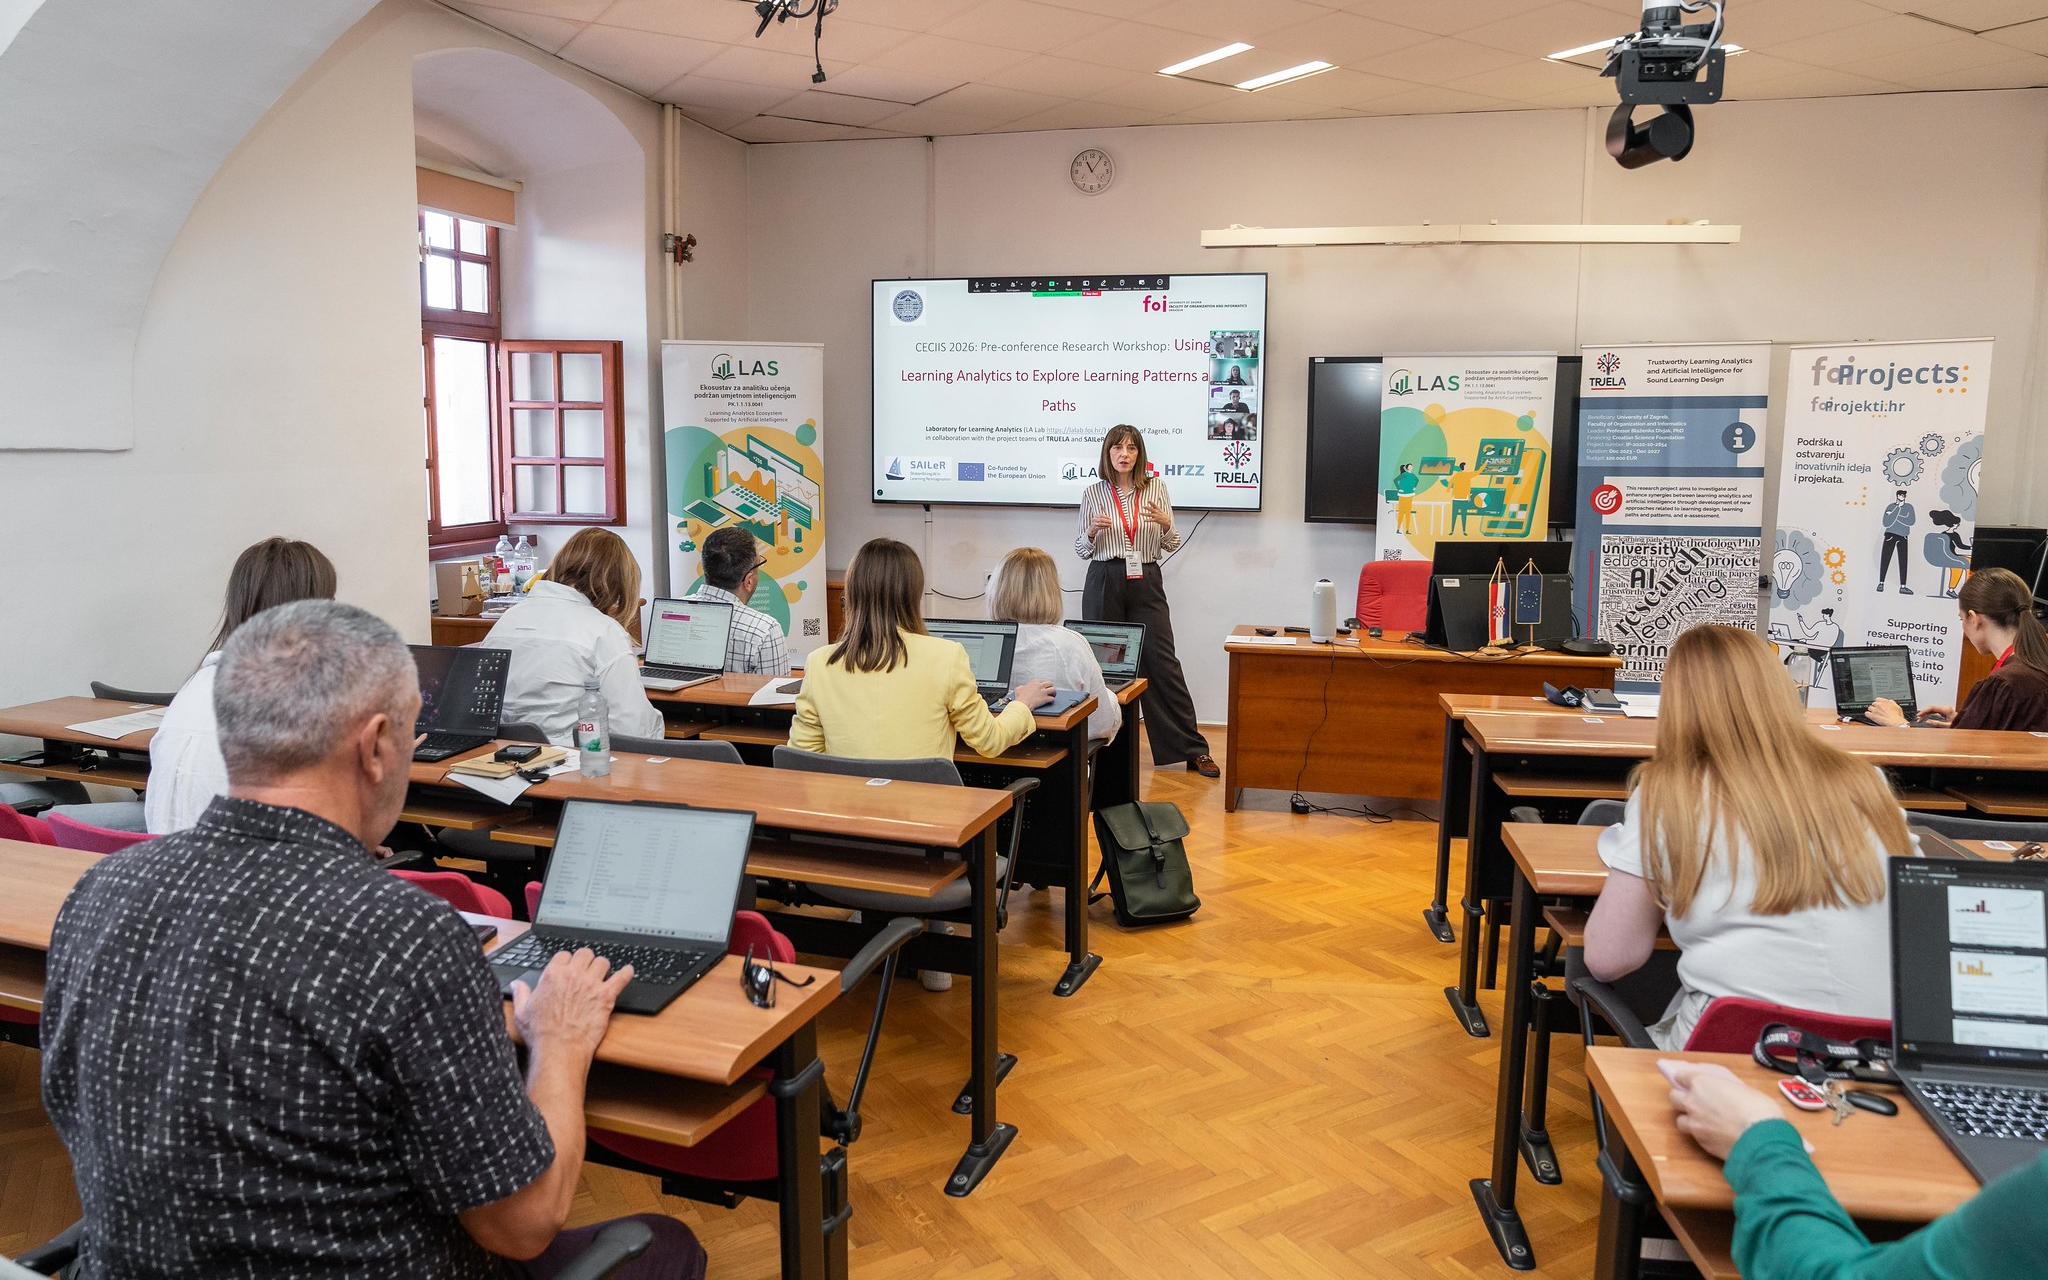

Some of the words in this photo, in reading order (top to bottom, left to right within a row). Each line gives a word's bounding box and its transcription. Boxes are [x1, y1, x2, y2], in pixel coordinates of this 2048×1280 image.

[1143, 295, 1167, 312] foi
[915, 342, 946, 352] CECIIS
[949, 342, 978, 352] 2026:
[981, 342, 1059, 352] Pre-conference
[1062, 342, 1109, 352] Research
[1112, 342, 1170, 352] Workshop:
[1174, 339, 1210, 353] Using
[739, 360, 778, 376] LAS
[901, 370, 953, 384] Learning
[956, 370, 1012, 384] Analytics
[1016, 371, 1028, 382] to
[1033, 370, 1080, 384] Explore
[1084, 370, 1139, 384] Learning
[1143, 370, 1197, 382] Patterns
[1418, 376, 1460, 391] LAS
[1042, 400, 1076, 412] Paths
[1797, 438, 1834, 446] Podrška
[1796, 450, 1844, 460] ostvarenju
[910, 461, 946, 469] SAILeR
[1794, 462, 1845, 471] inovativnih
[1847, 463, 1871, 473] ideja
[1080, 467, 1098, 478] LA
[1798, 475, 1844, 484] projekata.
[1670, 538, 1737, 550] methodology
[1739, 539, 1760, 547] PhD
[1602, 542, 1678, 559] university
[1604, 554, 1675, 567] education
[1706, 554, 1756, 568] project
[1631, 568, 1654, 588] AI
[1684, 575, 1707, 584] data
[1692, 570, 1727, 578] scientific
[1615, 546, 1706, 636] research
[1630, 578, 1727, 643] learning
[1887, 619, 1948, 635] Supporting
[1868, 630, 1929, 644] researchers
[1932, 637, 1944, 645] to
[1922, 660, 1944, 670] into
[1911, 673, 1942, 685] eality.
[577, 723, 594, 732] ana
